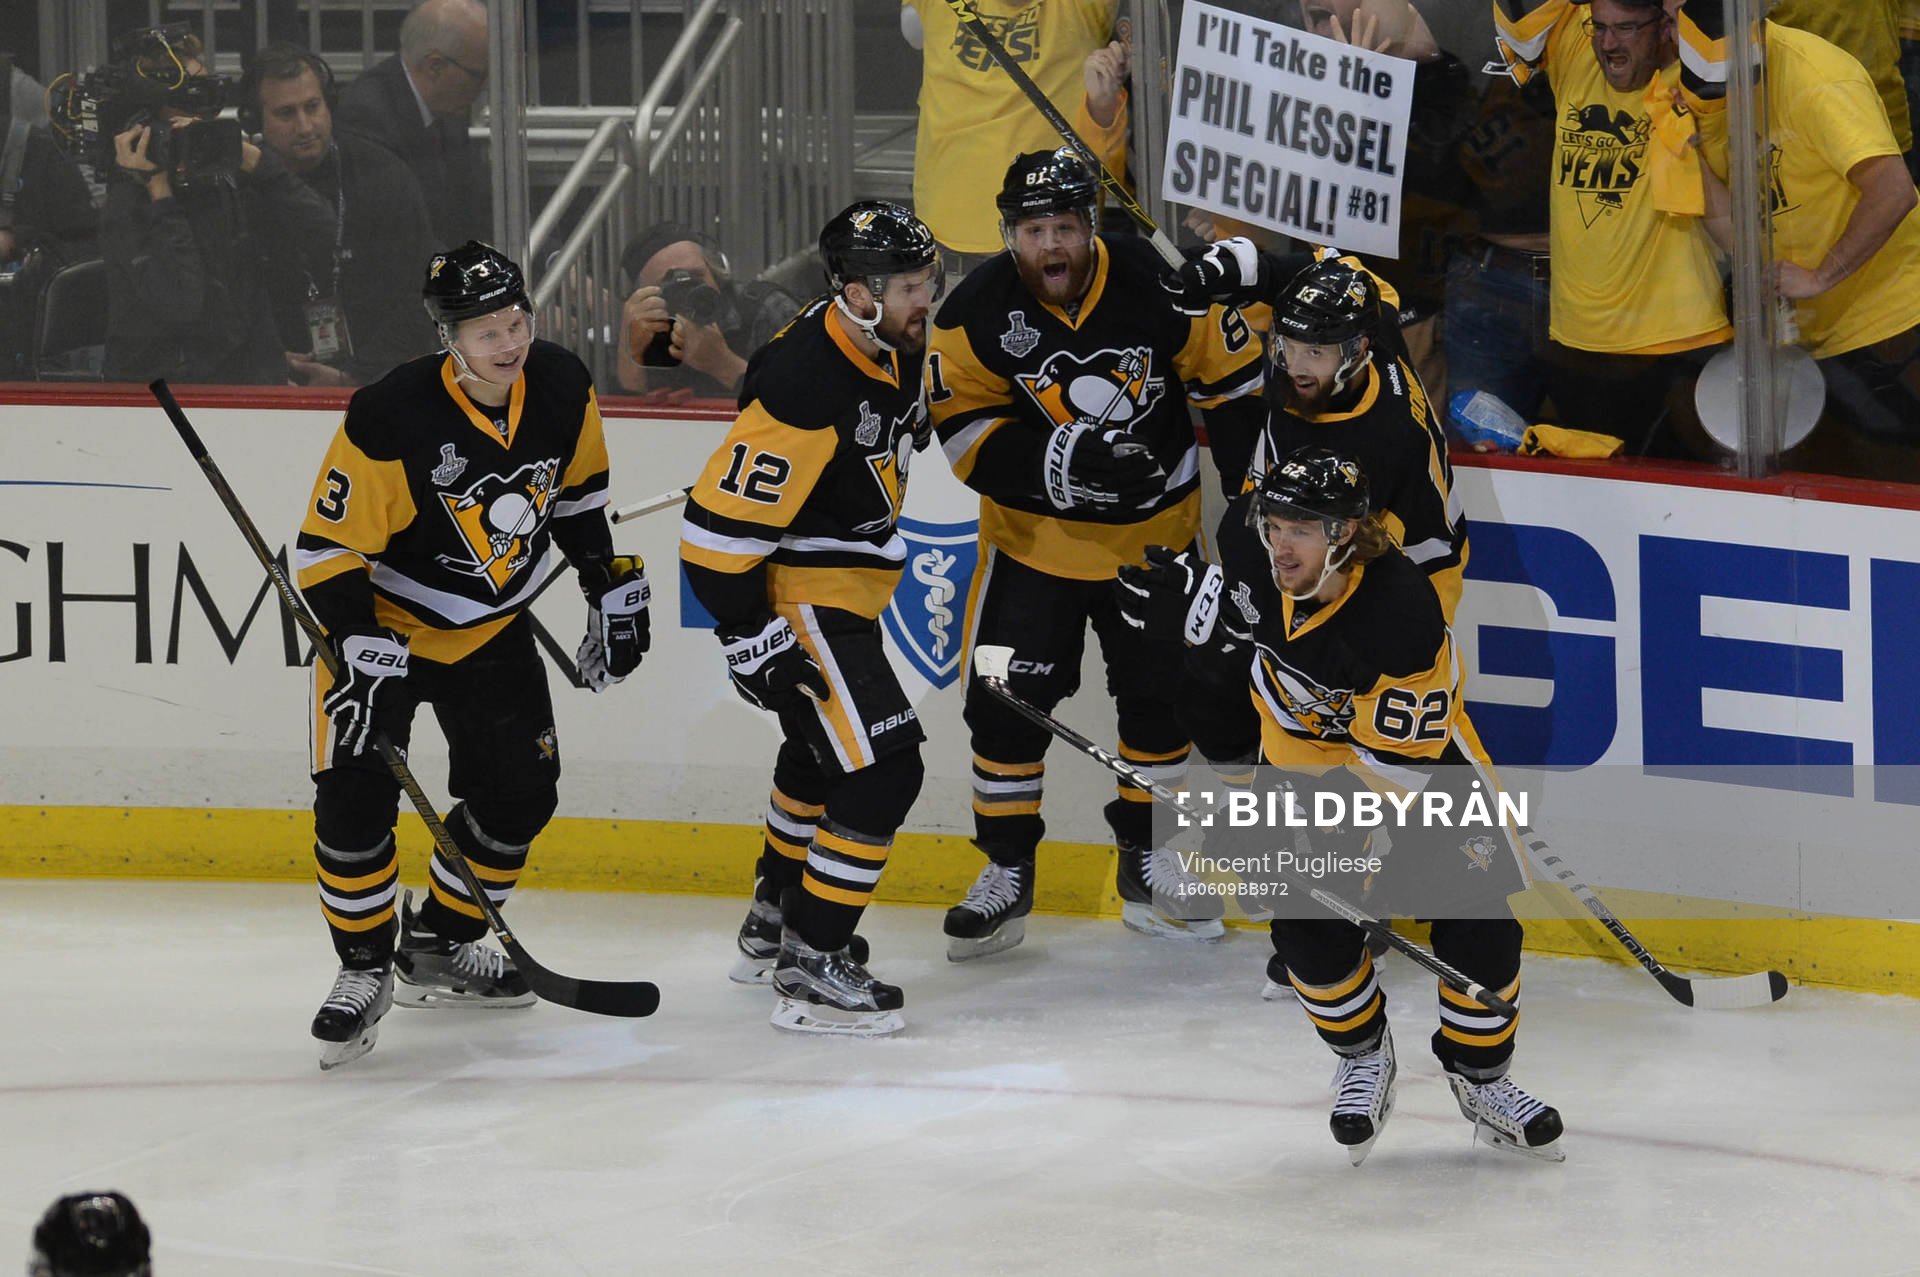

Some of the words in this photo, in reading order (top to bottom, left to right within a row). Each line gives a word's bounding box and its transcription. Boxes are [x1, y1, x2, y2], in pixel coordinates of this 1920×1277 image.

[1252, 28, 1327, 81] Take
[1339, 55, 1393, 98] the
[1177, 65, 1255, 138] PHIL
[1265, 90, 1396, 176] KESSEL
[1171, 140, 1339, 237] SPECIAL!
[1348, 185, 1391, 225] #81
[1557, 143, 1647, 189] PENS
[1281, 316, 1310, 332] CCM
[1387, 362, 1402, 396] Reebok
[315, 466, 352, 523] 3
[717, 442, 792, 505] 12
[1265, 491, 1294, 503] CCM
[1281, 462, 1306, 479] 62
[1191, 572, 1224, 638] CCM
[1008, 660, 1055, 675] CM
[1373, 687, 1450, 745] 62
